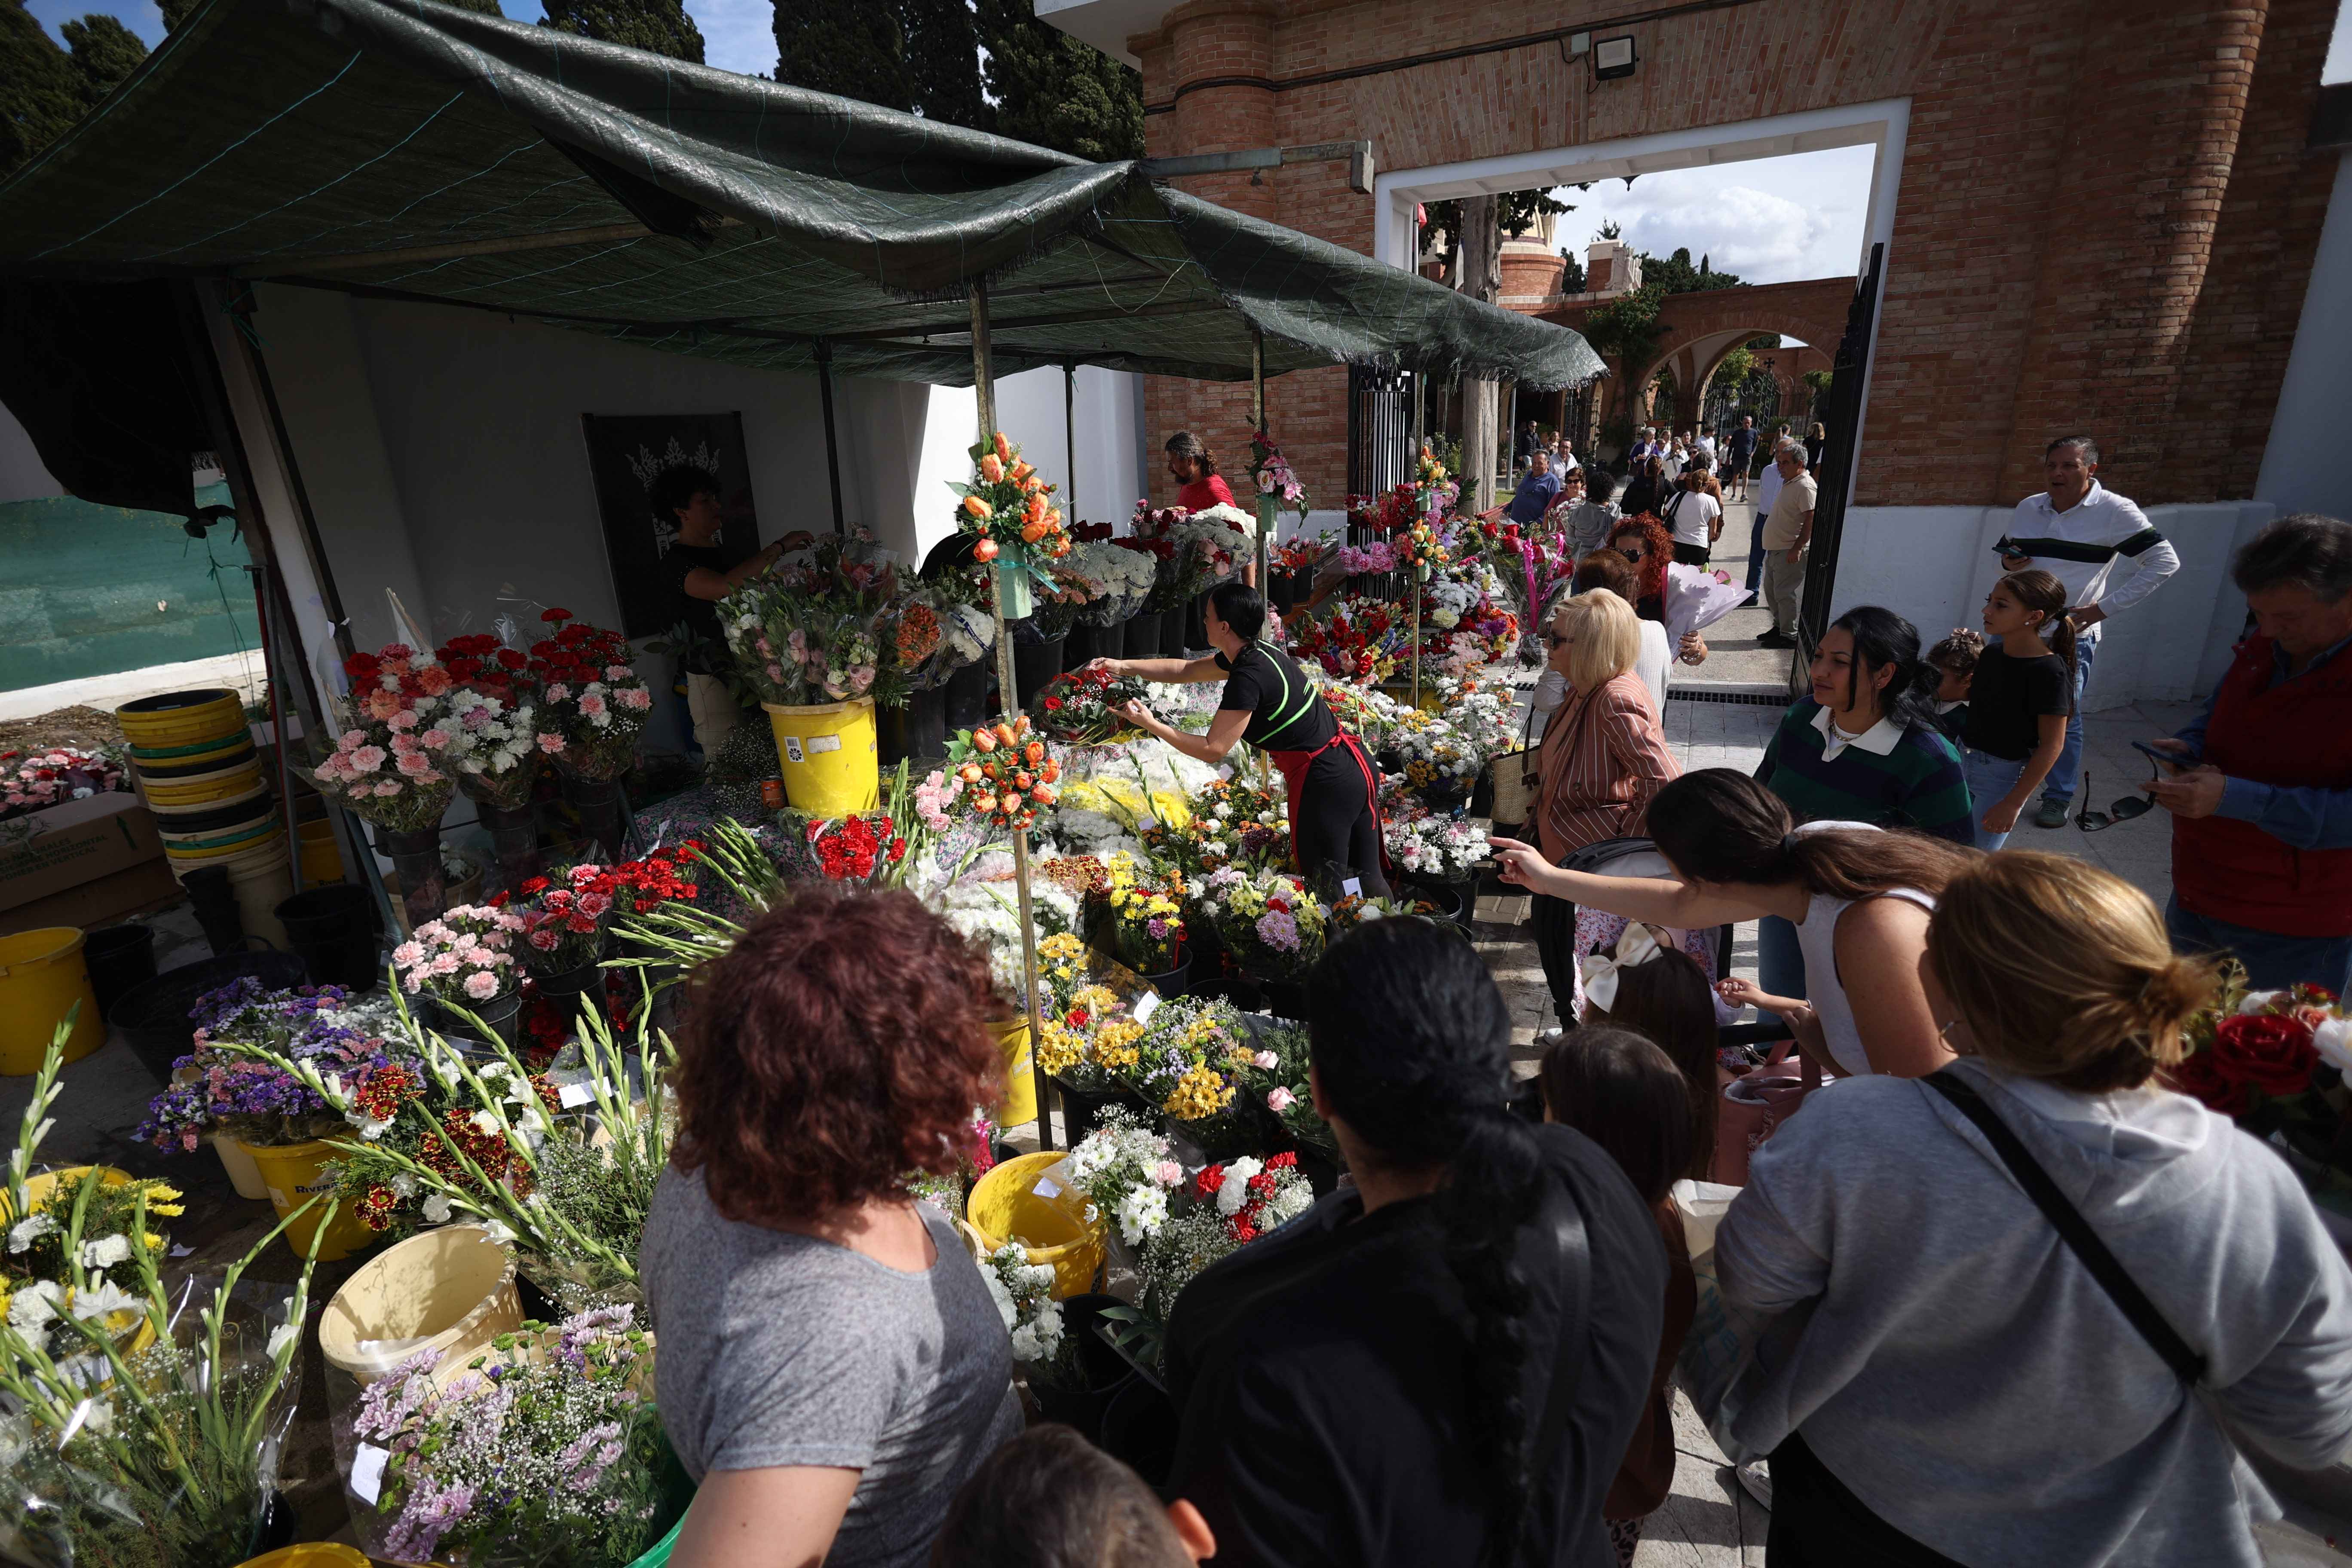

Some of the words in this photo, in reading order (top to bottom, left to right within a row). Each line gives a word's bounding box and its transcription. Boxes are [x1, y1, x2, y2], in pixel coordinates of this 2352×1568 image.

[35, 861, 50, 871] EN
[50, 846, 98, 866] VERTICAL
[45, 834, 109, 859] HORIZONTAL
